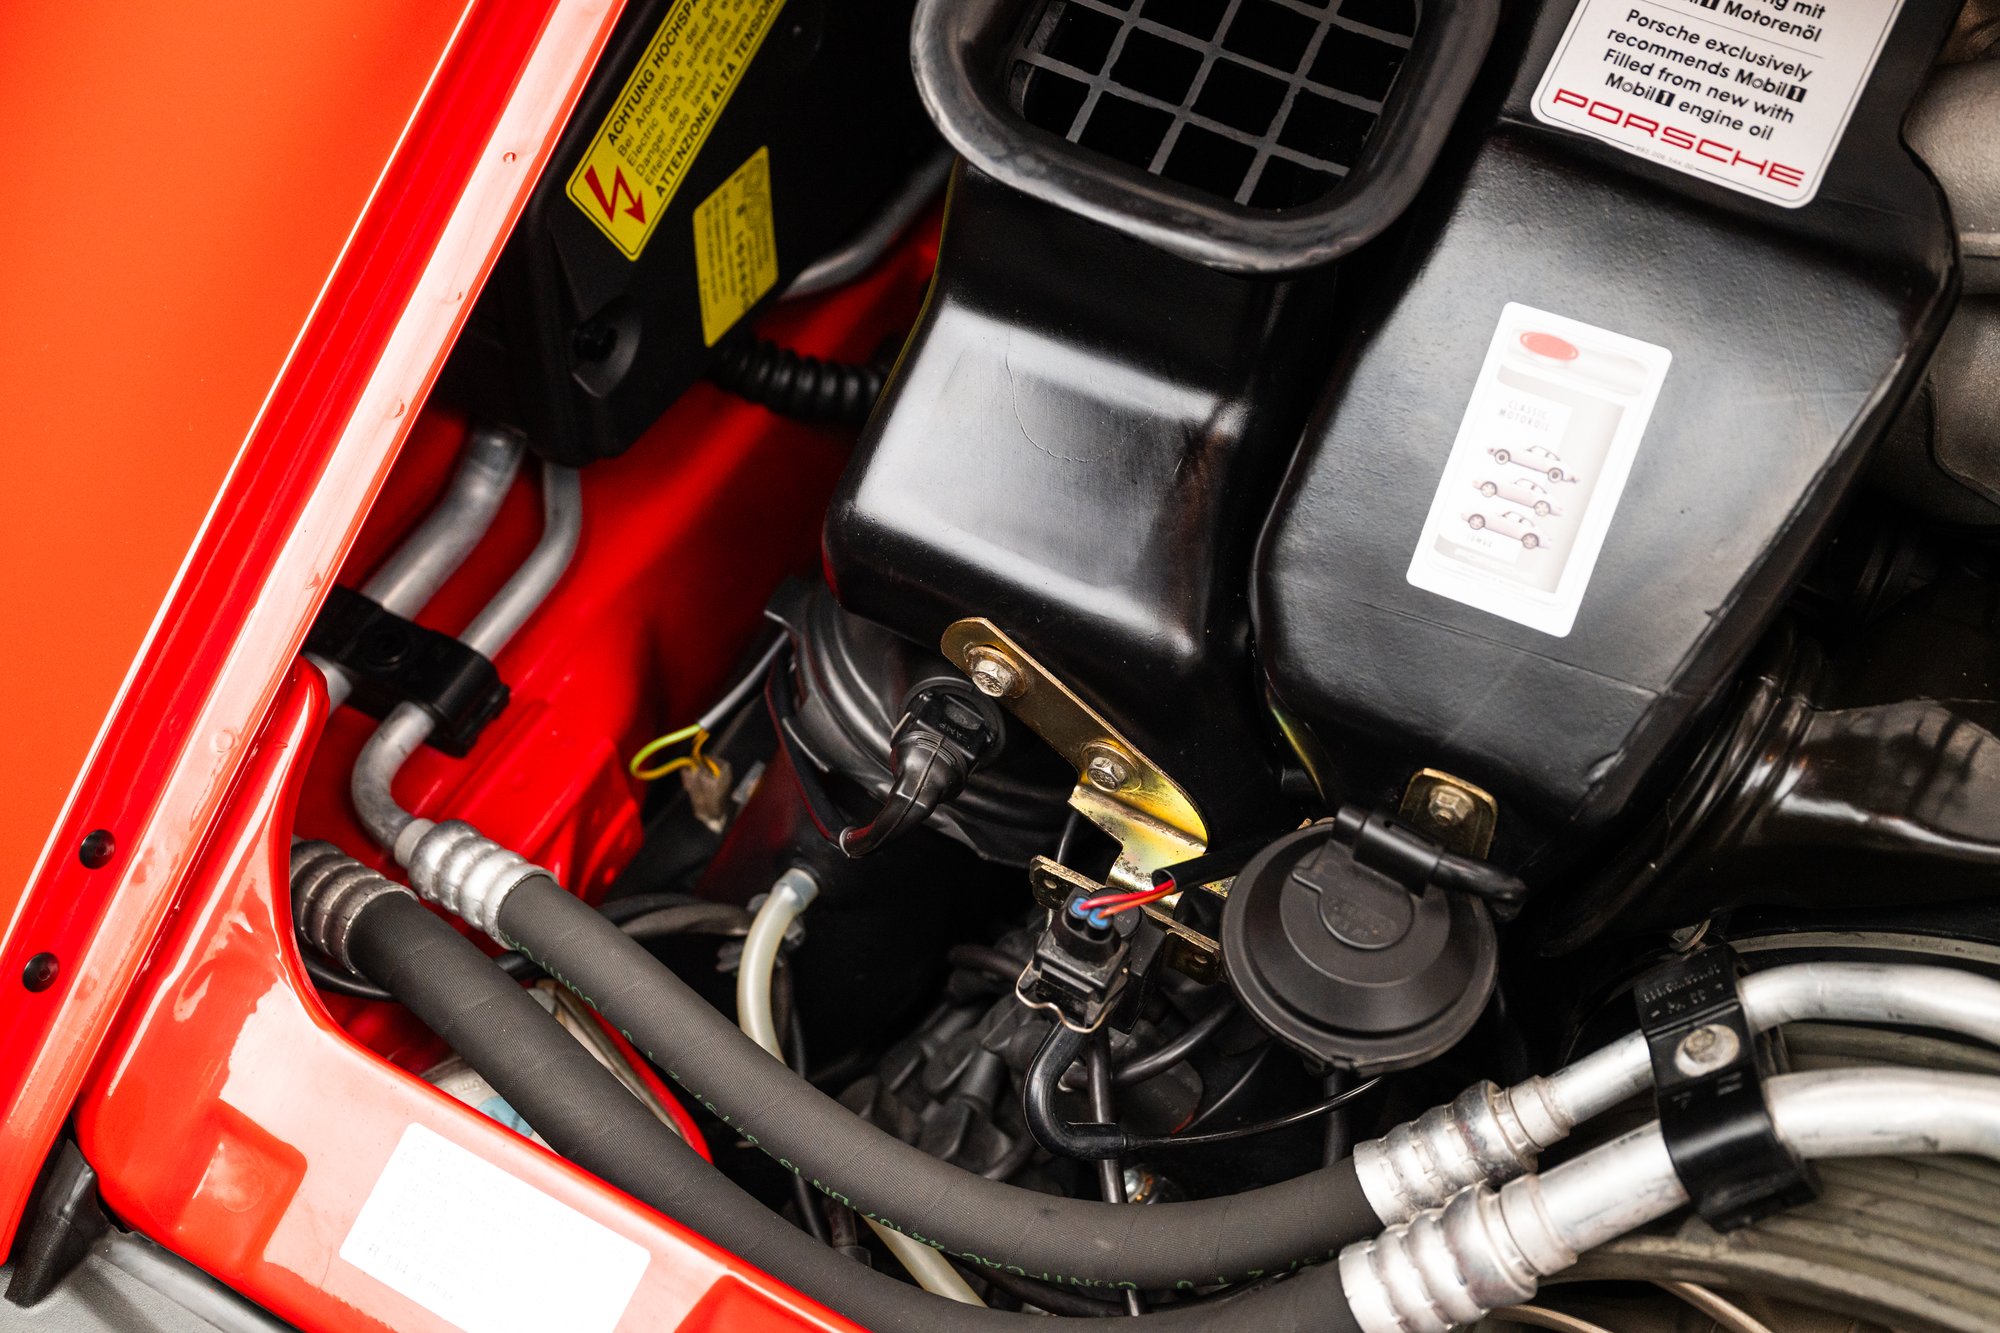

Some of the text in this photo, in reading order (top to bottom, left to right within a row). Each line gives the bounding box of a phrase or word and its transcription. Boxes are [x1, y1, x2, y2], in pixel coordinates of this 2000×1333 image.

[1626, 9, 1812, 82] Porsche exclusively
[1724, 1, 1822, 42] Motorenöl
[1793, 2, 1825, 19] mit
[618, 135, 634, 157] Bei
[636, 74, 670, 128] Arbeiten
[672, 51, 683, 68] an
[686, 22, 699, 45] der
[627, 118, 658, 166] Electric
[661, 75, 685, 112] shock
[687, 15, 718, 68] suffered
[1604, 49, 1793, 123] Filled from new with
[1608, 30, 1729, 78] recommends
[609, 69, 654, 145] ACHTUNG
[636, 129, 665, 176] Danger
[668, 106, 680, 123] de
[682, 69, 701, 100] mort
[703, 47, 714, 65] en
[717, 19, 731, 42] cas
[645, 113, 689, 185] Effettuando
[691, 71, 714, 107] lavori
[656, 103, 712, 197] ATTENZIONE
[711, 63, 736, 102] ALTA
[1679, 102, 1743, 130] engine
[1749, 125, 1773, 140] oil
[1553, 89, 1805, 187] PORSCHE
